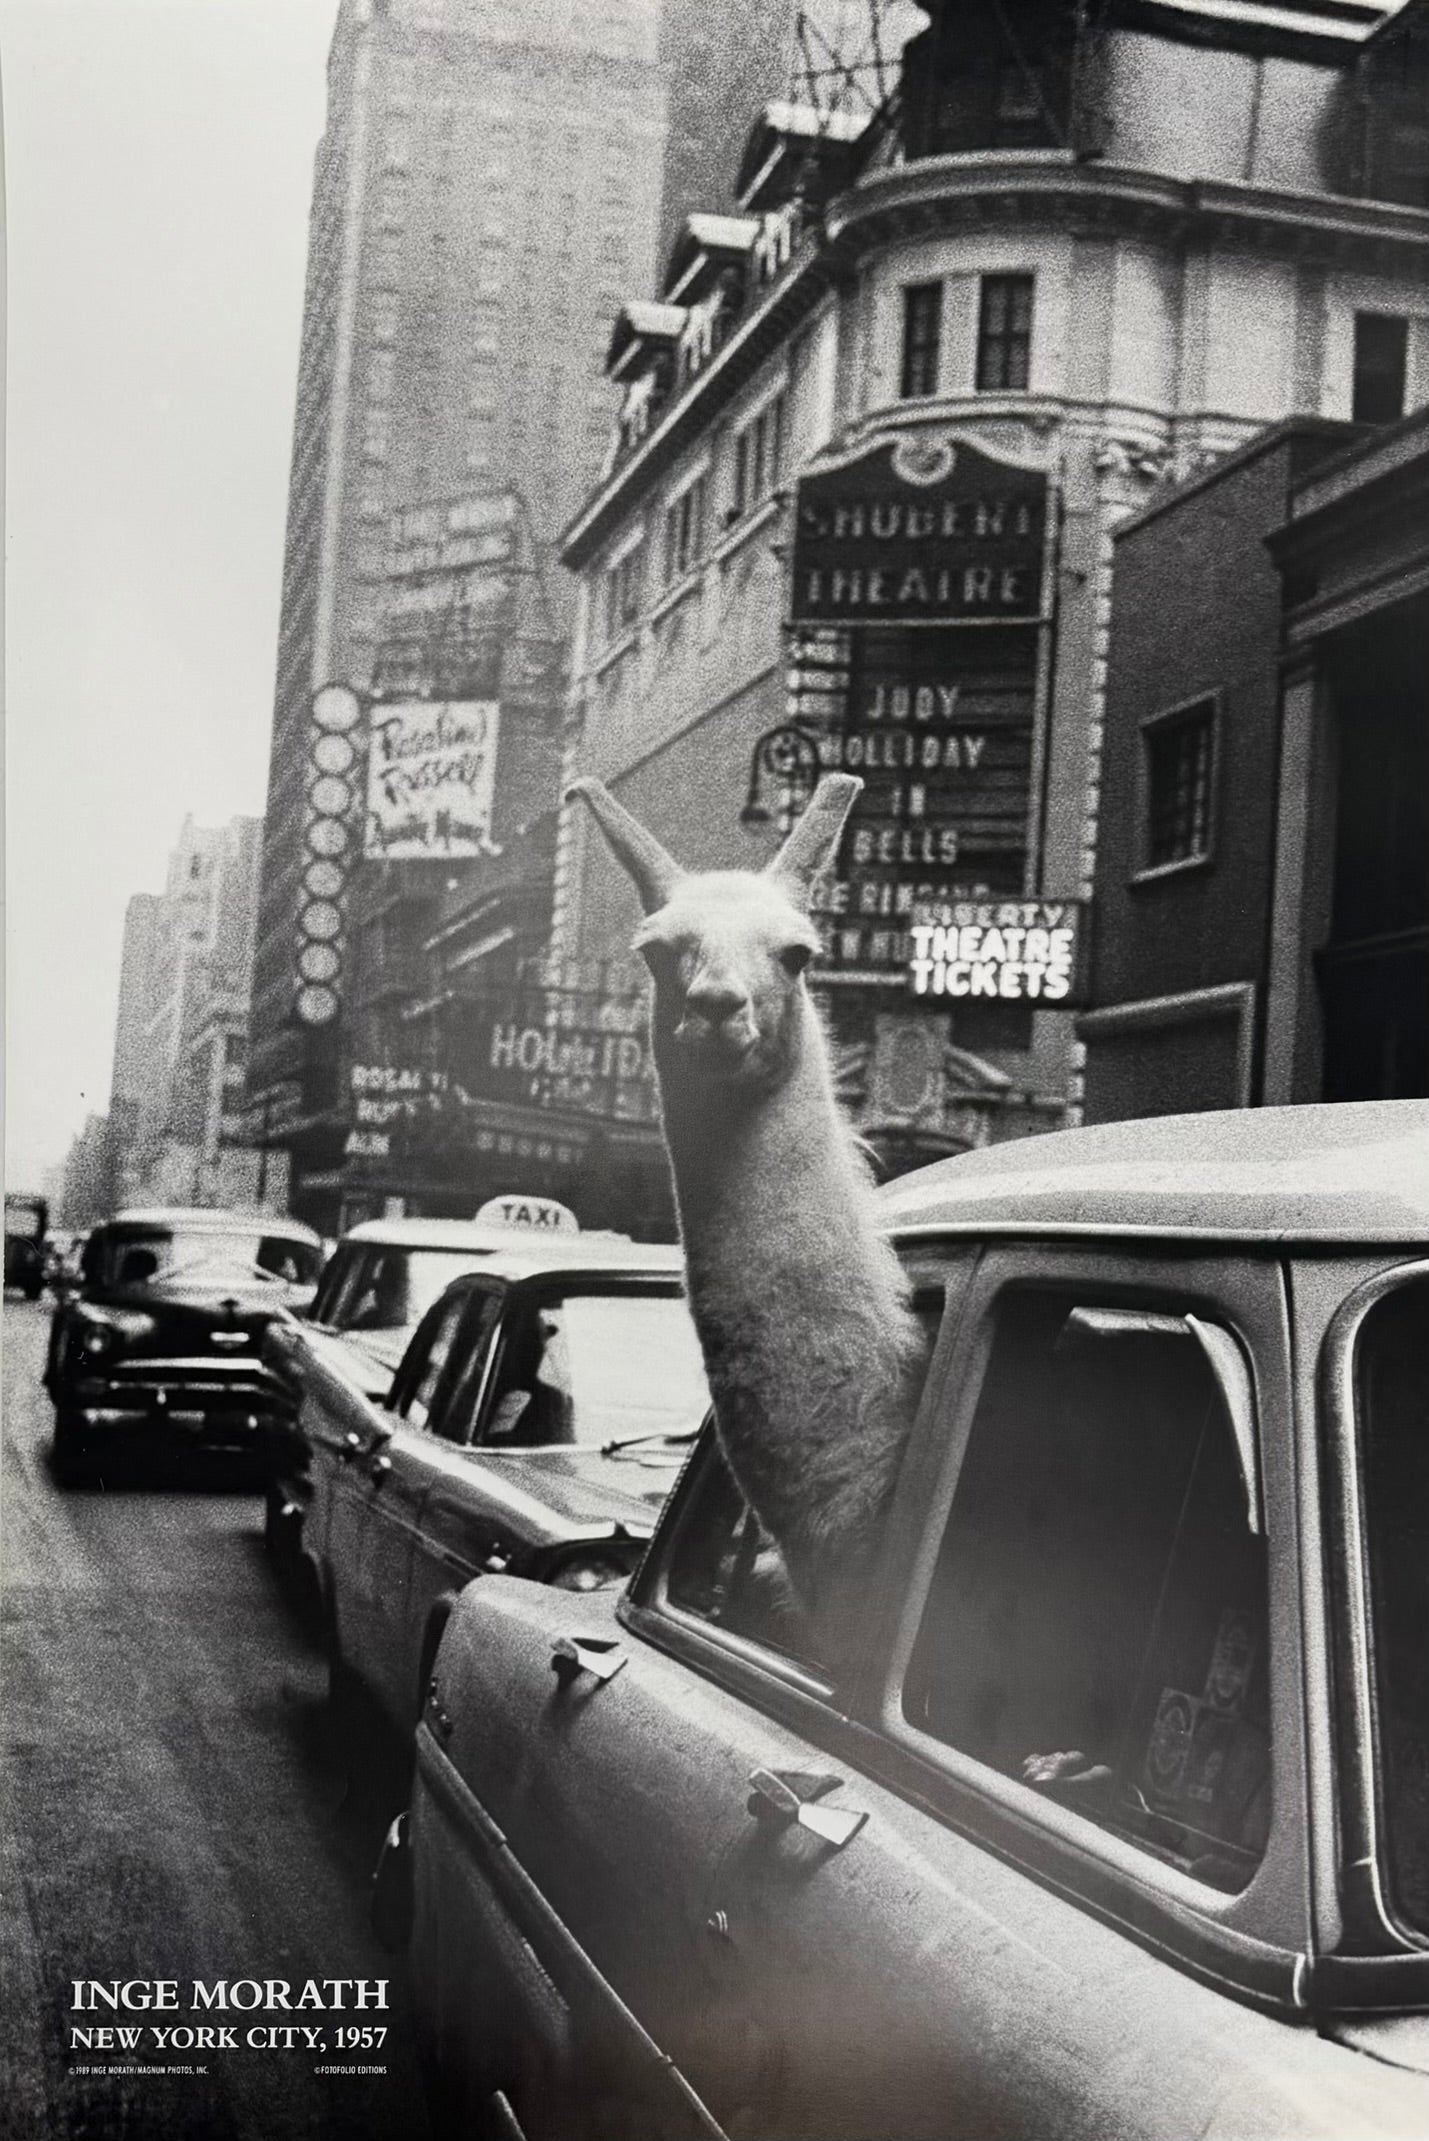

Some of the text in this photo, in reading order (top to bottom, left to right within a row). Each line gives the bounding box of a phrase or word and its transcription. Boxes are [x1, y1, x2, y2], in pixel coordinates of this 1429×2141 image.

[910, 925, 1075, 963] THEATRE
[909, 960, 1071, 999] TICKETS
[501, 1203, 561, 1227] TAXI
